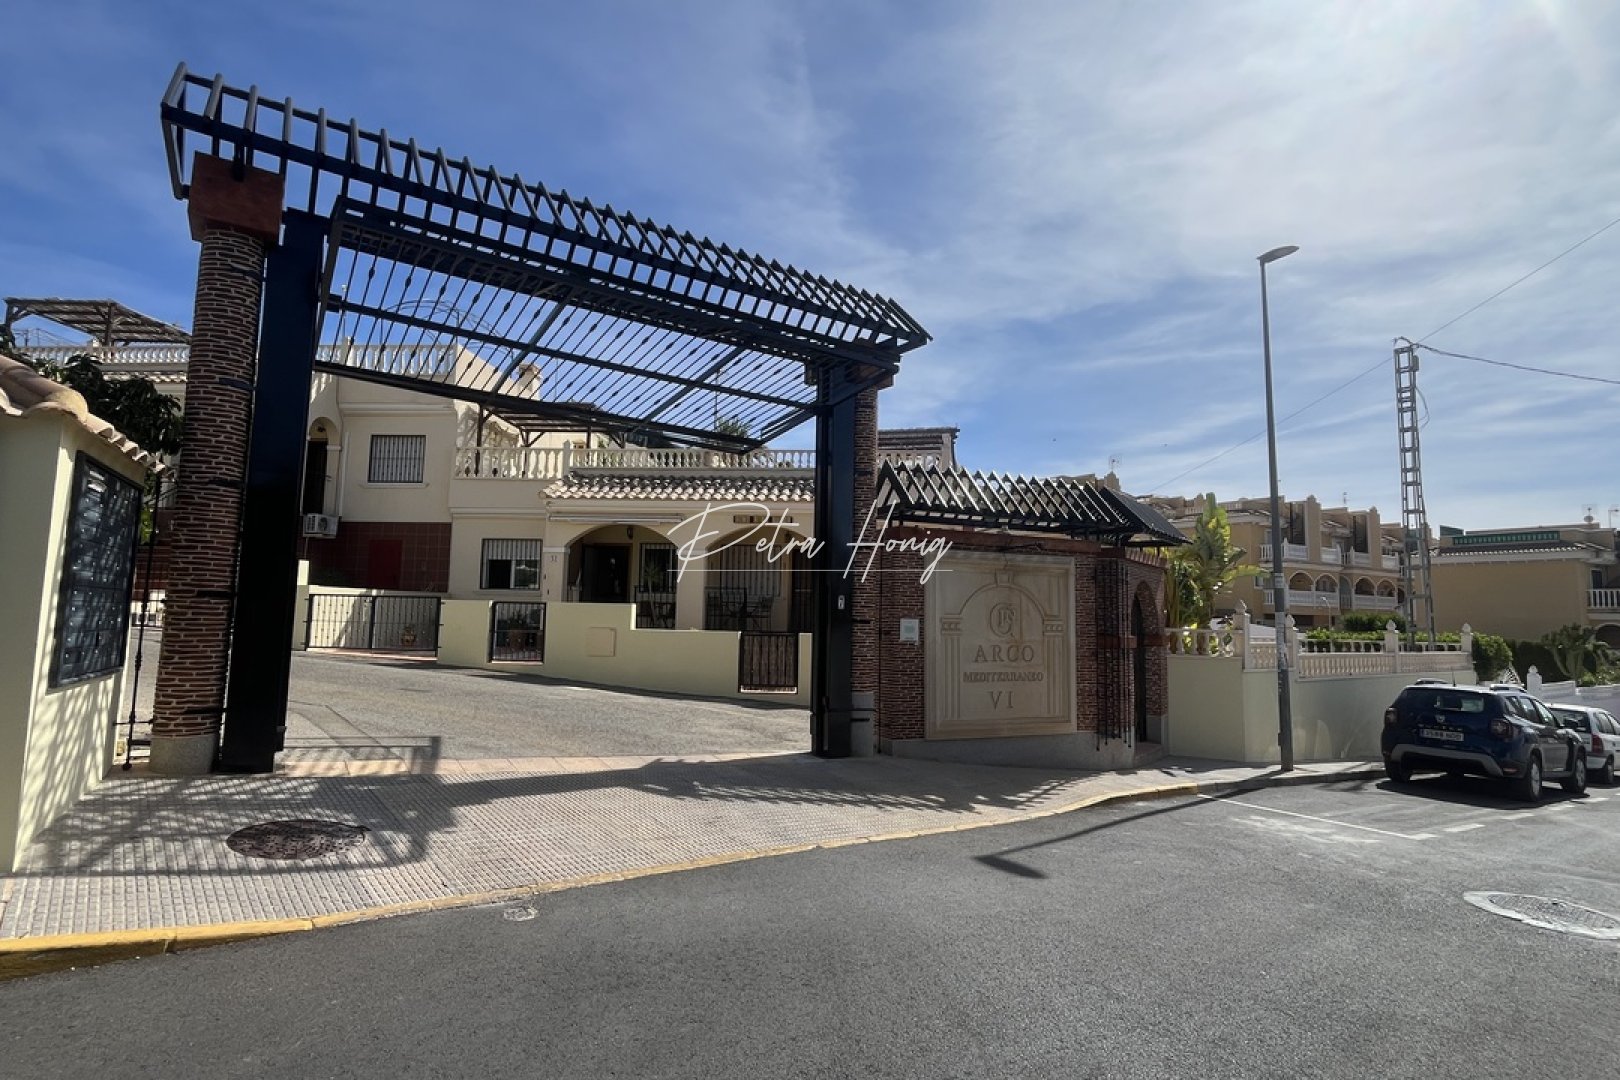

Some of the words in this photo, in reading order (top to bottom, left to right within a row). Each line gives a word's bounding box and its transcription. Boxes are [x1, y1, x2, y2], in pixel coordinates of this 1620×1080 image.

[973, 644, 1035, 664] ARCO
[962, 671, 1045, 683] MEDITERRANEO
[987, 690, 1015, 710] VI
